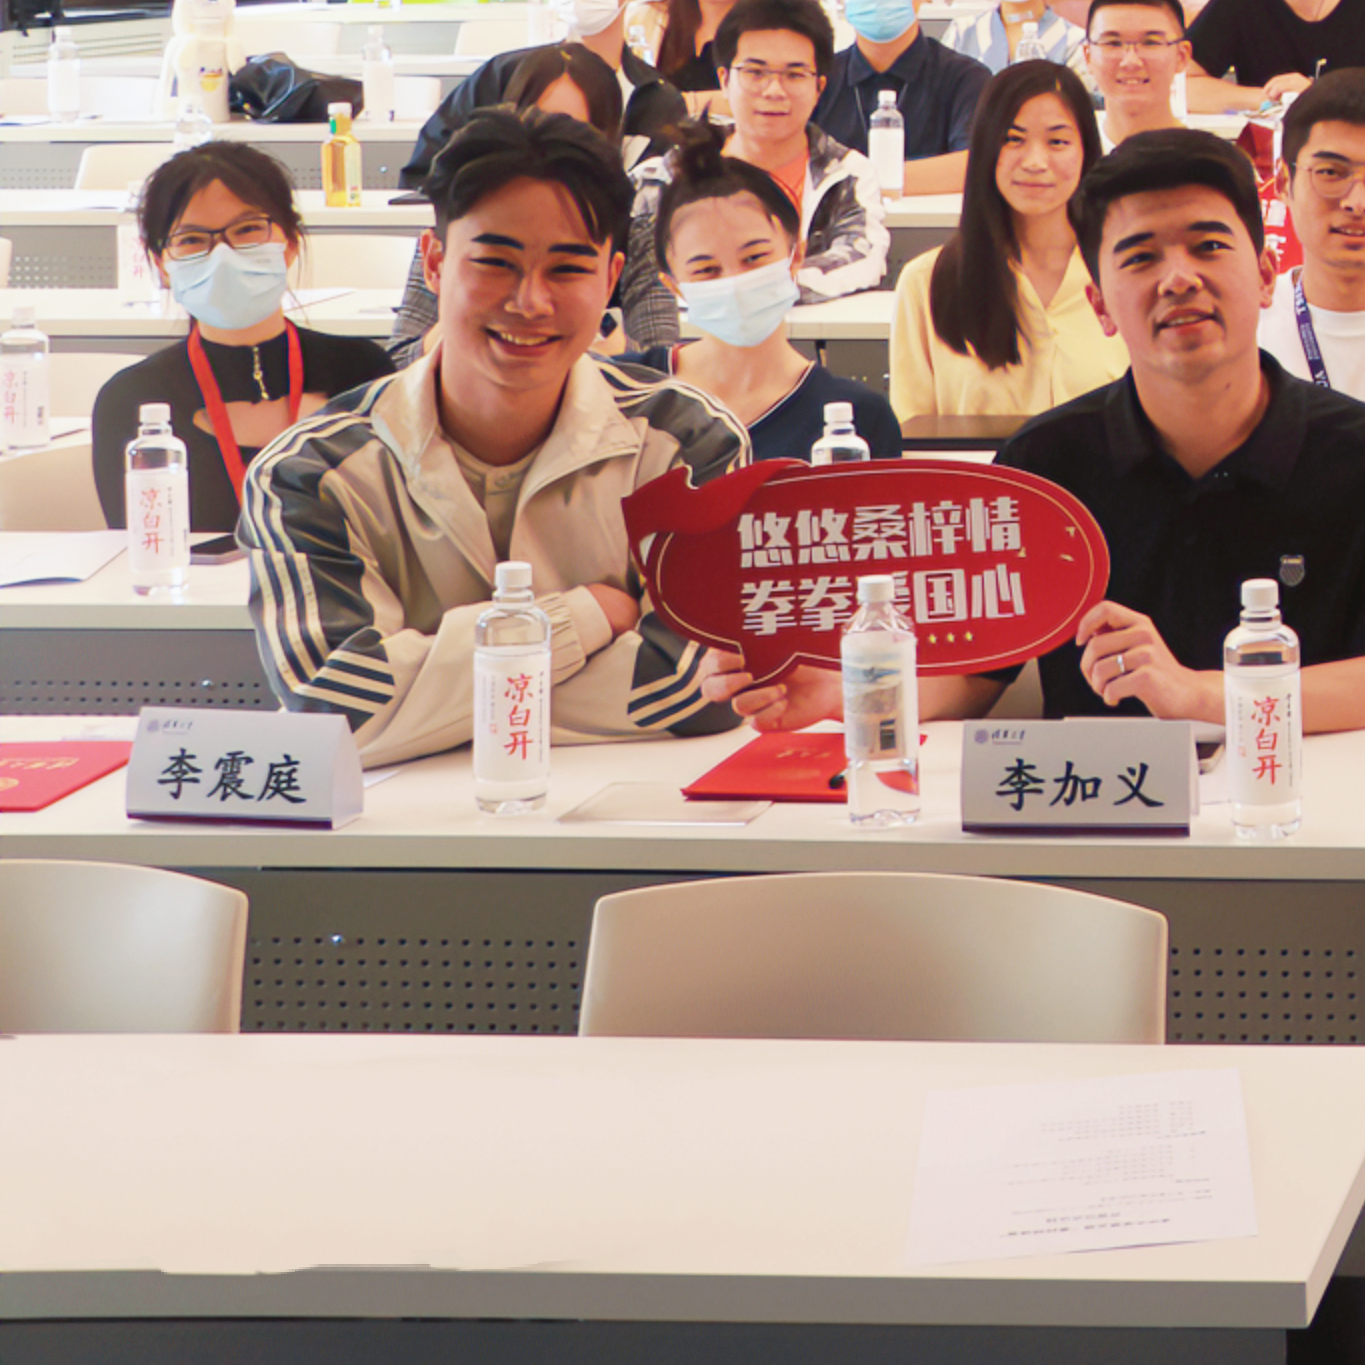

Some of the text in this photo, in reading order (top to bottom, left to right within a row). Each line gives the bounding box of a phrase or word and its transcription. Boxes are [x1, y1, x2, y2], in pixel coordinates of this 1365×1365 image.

[140, 488, 164, 554] 凉白开
[737, 496, 1021, 568] 悠悠桑梓情
[504, 673, 533, 760] 凉白开
[1251, 696, 1282, 785] 凉白开
[157, 747, 306, 803] 李震庭
[996, 758, 1164, 811] 李加义
